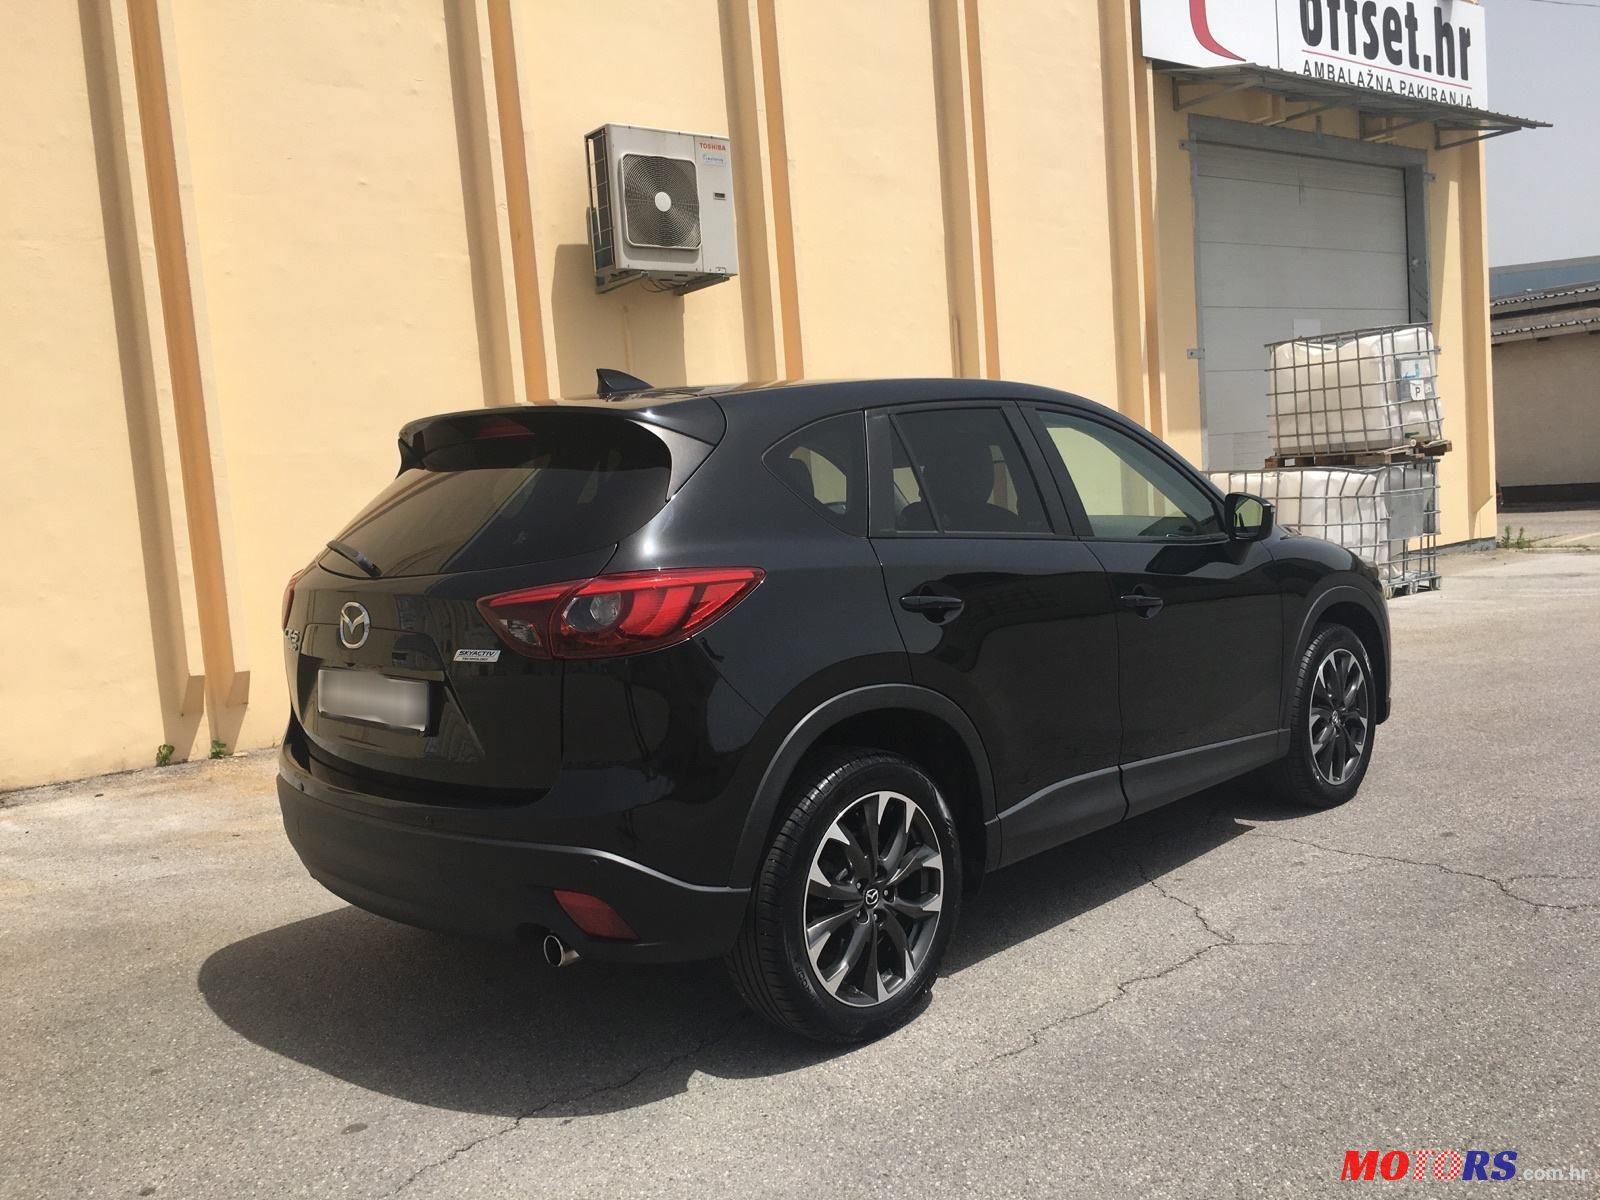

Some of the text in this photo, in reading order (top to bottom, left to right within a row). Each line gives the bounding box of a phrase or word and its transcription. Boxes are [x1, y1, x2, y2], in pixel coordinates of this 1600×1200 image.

[1303, 59, 1395, 94] AMBALAŽNA
[699, 142, 726, 151] TOSHIBA
[1415, 386, 1421, 398] P
